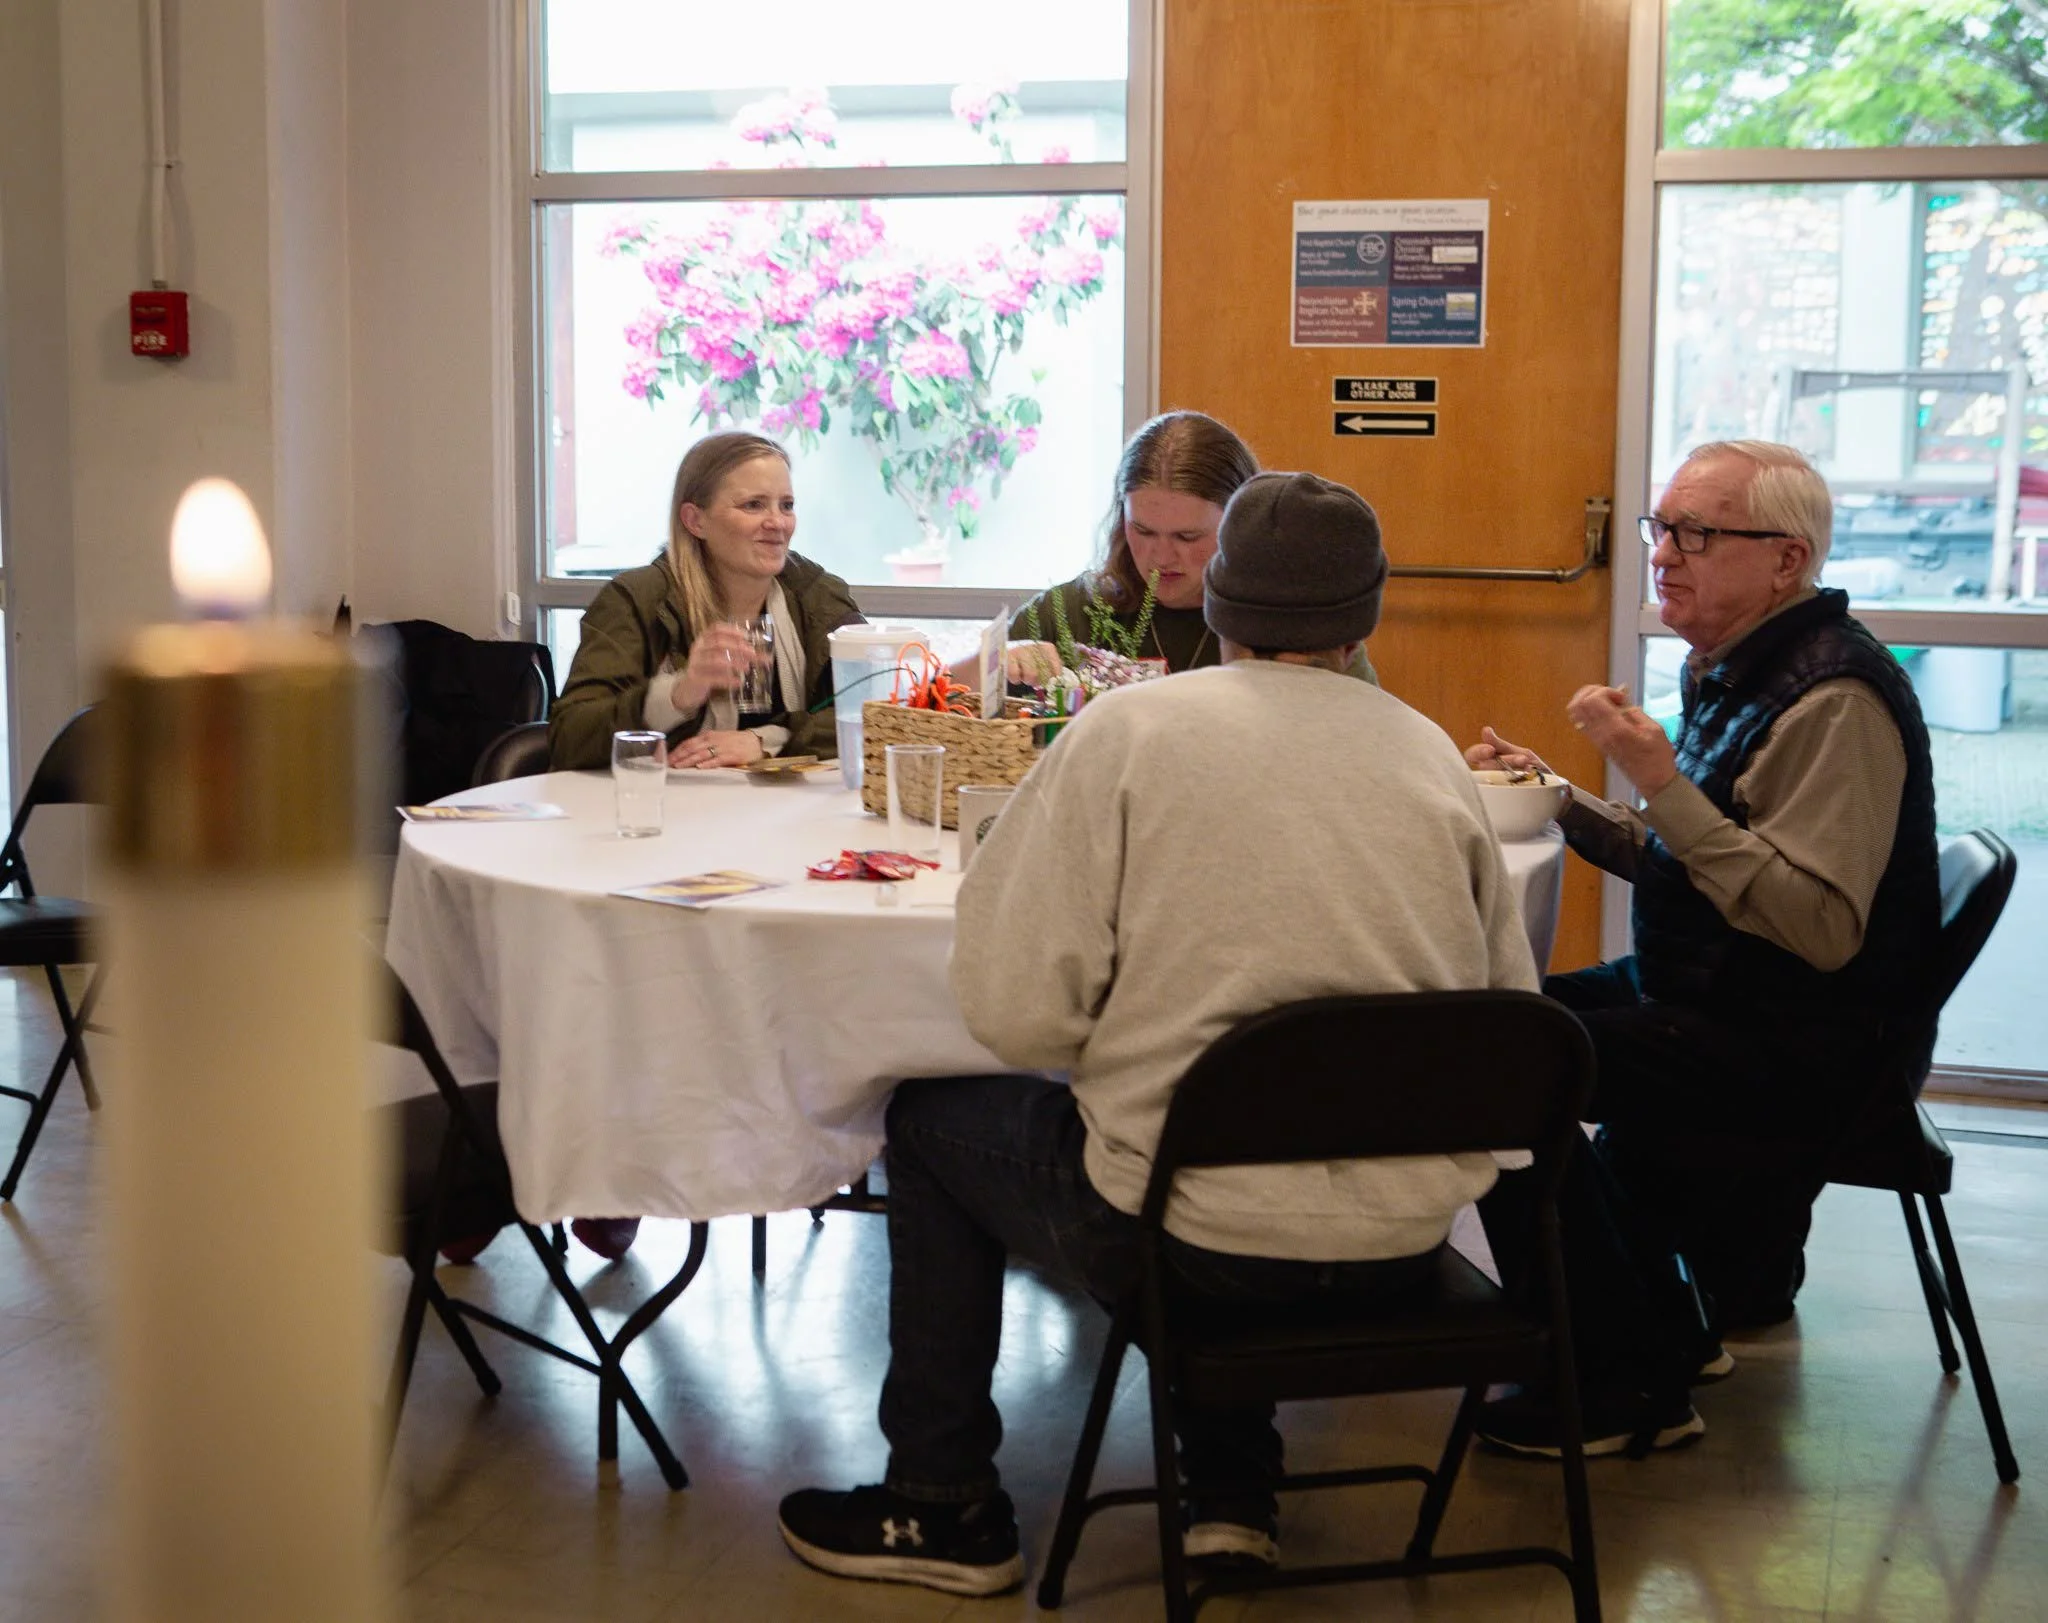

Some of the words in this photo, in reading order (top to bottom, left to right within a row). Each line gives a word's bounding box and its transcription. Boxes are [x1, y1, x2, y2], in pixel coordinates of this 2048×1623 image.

[1392, 296, 1417, 308] Spring
[1419, 296, 1445, 306] Church
[1350, 382, 1390, 390] PLEASE
[1396, 382, 1416, 391] USE
[1350, 390, 1384, 399] OTHER
[1388, 391, 1416, 399] DOOR
